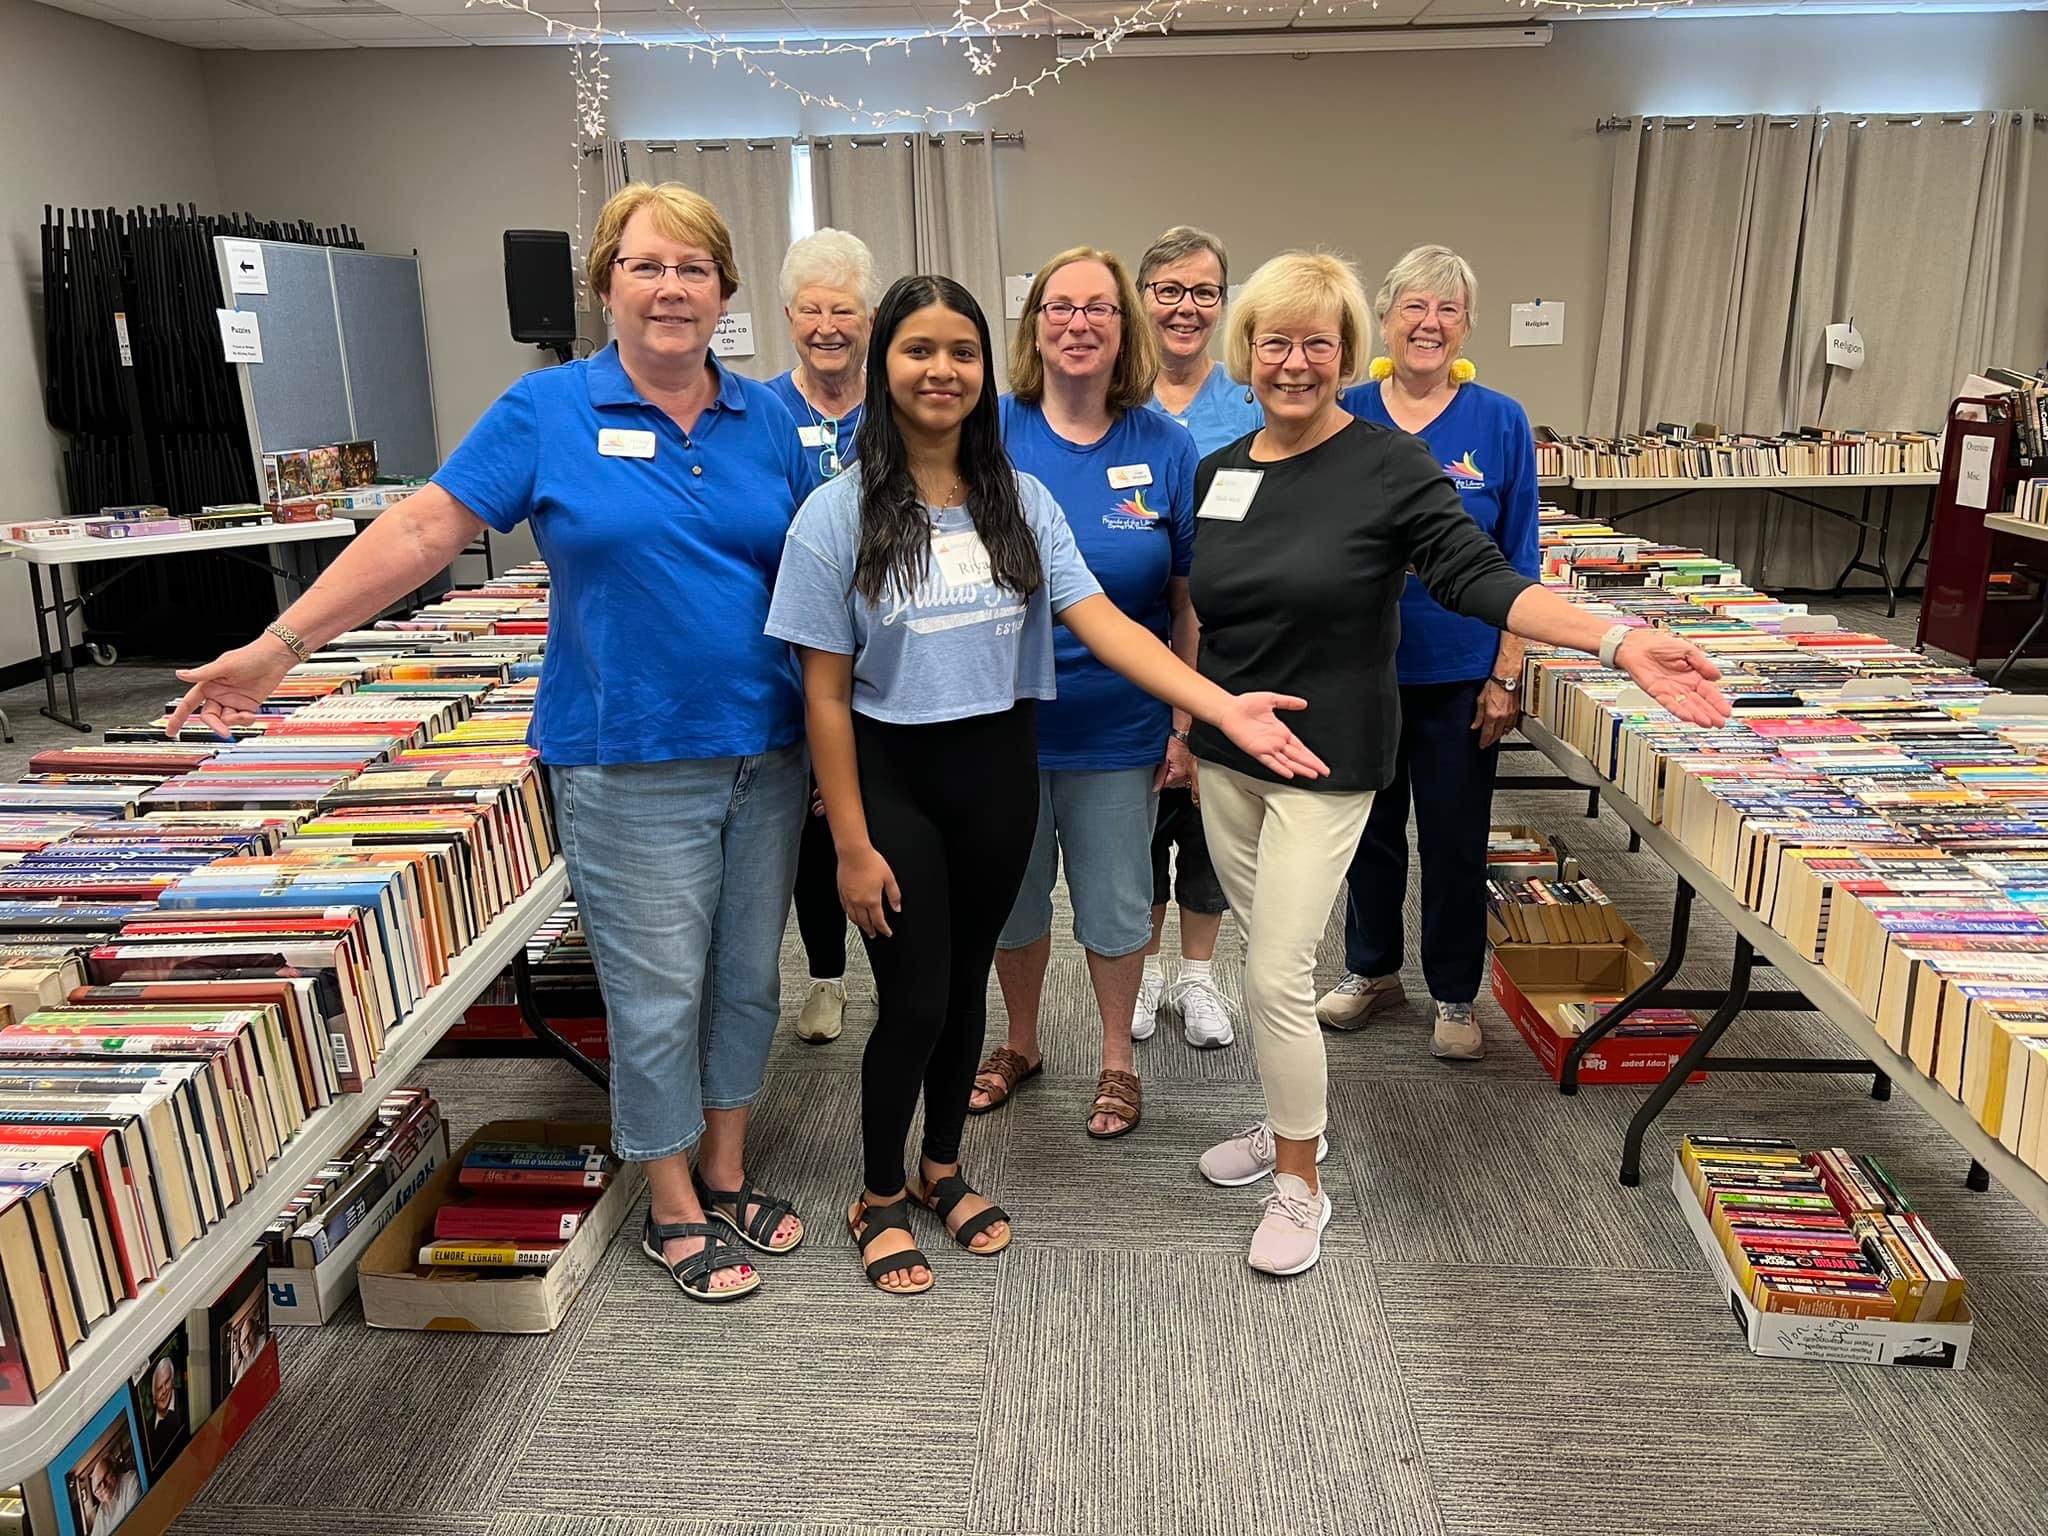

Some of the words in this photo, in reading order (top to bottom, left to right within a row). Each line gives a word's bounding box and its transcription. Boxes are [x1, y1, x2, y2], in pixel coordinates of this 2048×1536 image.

[1525, 320, 1550, 328] Religion
[231, 325, 252, 334] Puzzles
[1833, 338, 1863, 354] Religion
[958, 660, 992, 676] Riya
[16, 933, 60, 942] SPARKS
[1620, 1060, 1645, 1068] paper
[1646, 1060, 1666, 1068] copy
[435, 1250, 465, 1261] ELMORE
[468, 1254, 503, 1264] LEONARD
[518, 1252, 539, 1263] ROAD
[1813, 1258, 1845, 1269] BREAK
[1853, 1340, 1874, 1348] Papel
[1850, 1346, 1873, 1355] Papier
[1825, 1352, 1871, 1361] Multipurpose
